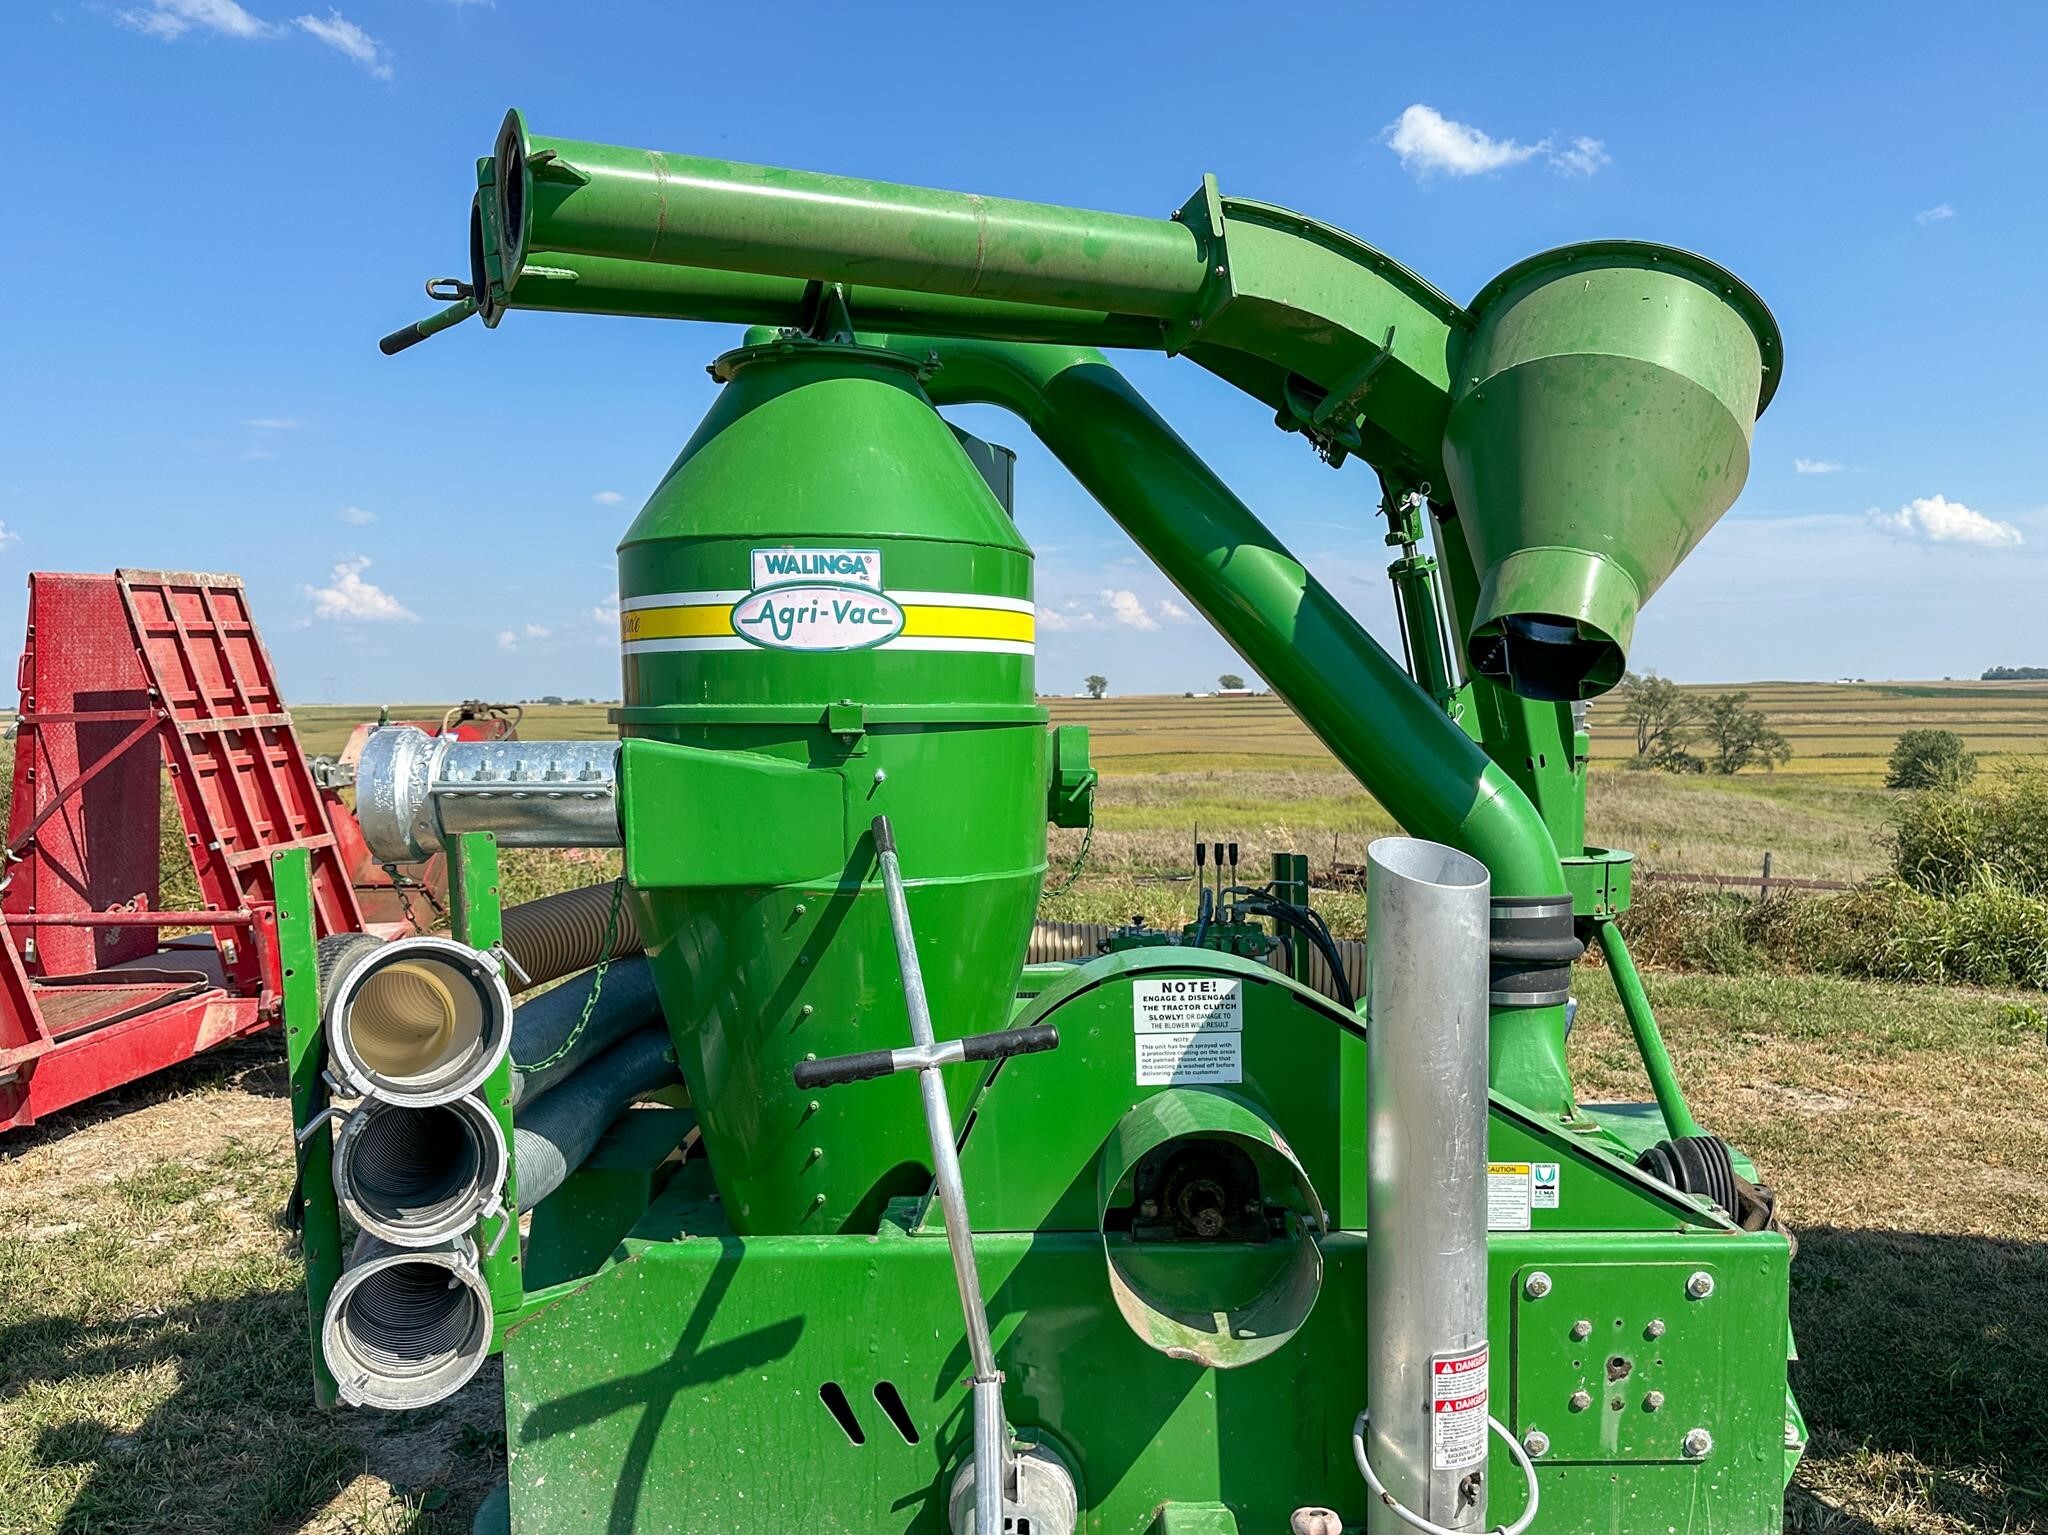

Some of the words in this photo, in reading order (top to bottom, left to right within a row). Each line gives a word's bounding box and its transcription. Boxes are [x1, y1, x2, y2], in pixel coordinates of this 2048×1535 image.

[1162, 982, 1216, 992] NOTE!
[1456, 1354, 1486, 1371] DANGER
[1456, 1391, 1486, 1410] DANGER
